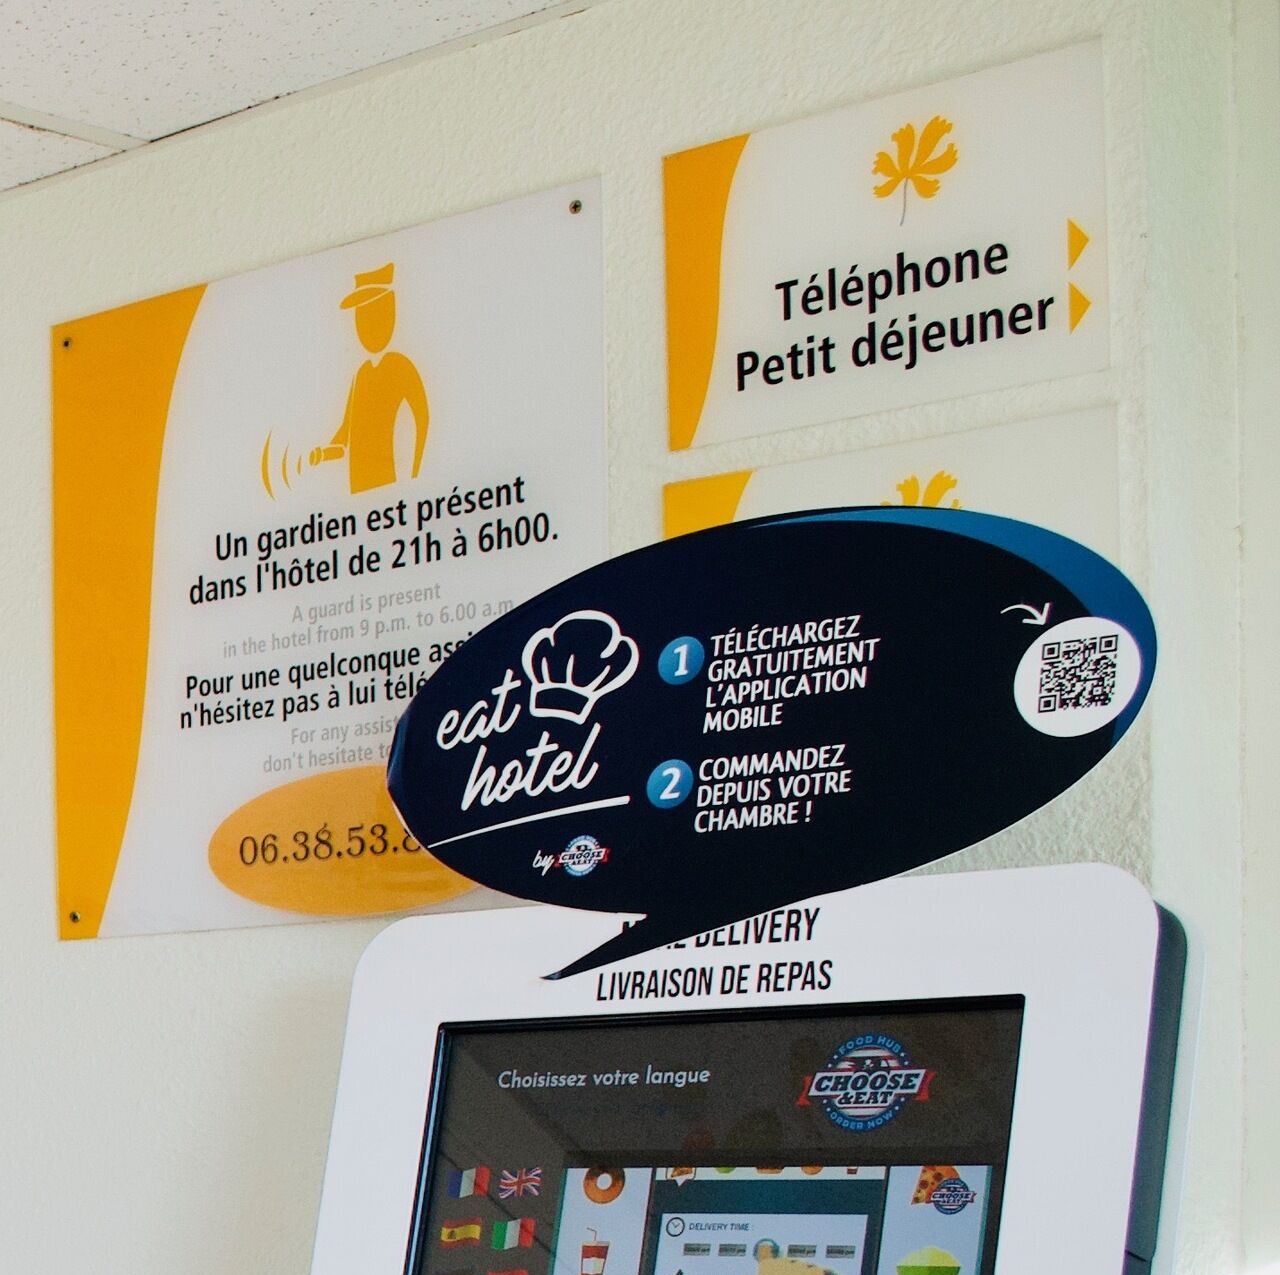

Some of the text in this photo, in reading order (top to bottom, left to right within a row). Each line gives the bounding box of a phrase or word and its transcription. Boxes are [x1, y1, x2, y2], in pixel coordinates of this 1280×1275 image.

[775, 240, 1008, 322] Téléphone
[736, 296, 1055, 392] Petit déjeuner
[215, 475, 525, 562] Un gardien est présent
[189, 511, 559, 605] dans l'hôtel de 21h à 6h00.
[292, 583, 441, 625] A guard is present
[672, 614, 862, 678] 1 TÉLÉCHARGEZ
[707, 637, 880, 683] GRATUITEMENT
[705, 667, 868, 709] L'APPLICATION
[436, 668, 522, 751] eat
[703, 704, 783, 734] MOBILE
[460, 722, 602, 812] hotel
[659, 744, 846, 801] 2 COMMANDEZ
[697, 770, 852, 808] DEPUIS VOTRE
[694, 801, 798, 833] CHAMBRE
[533, 849, 555, 876] by
[597, 960, 832, 1000] LIVRAISON DE REPAS
[497, 1065, 711, 1090] Choisissez votre langue
[814, 1073, 920, 1091] CHOOSE
[839, 1091, 893, 1105] &EAT
[689, 1223, 750, 1231] DELIVERY TIME
